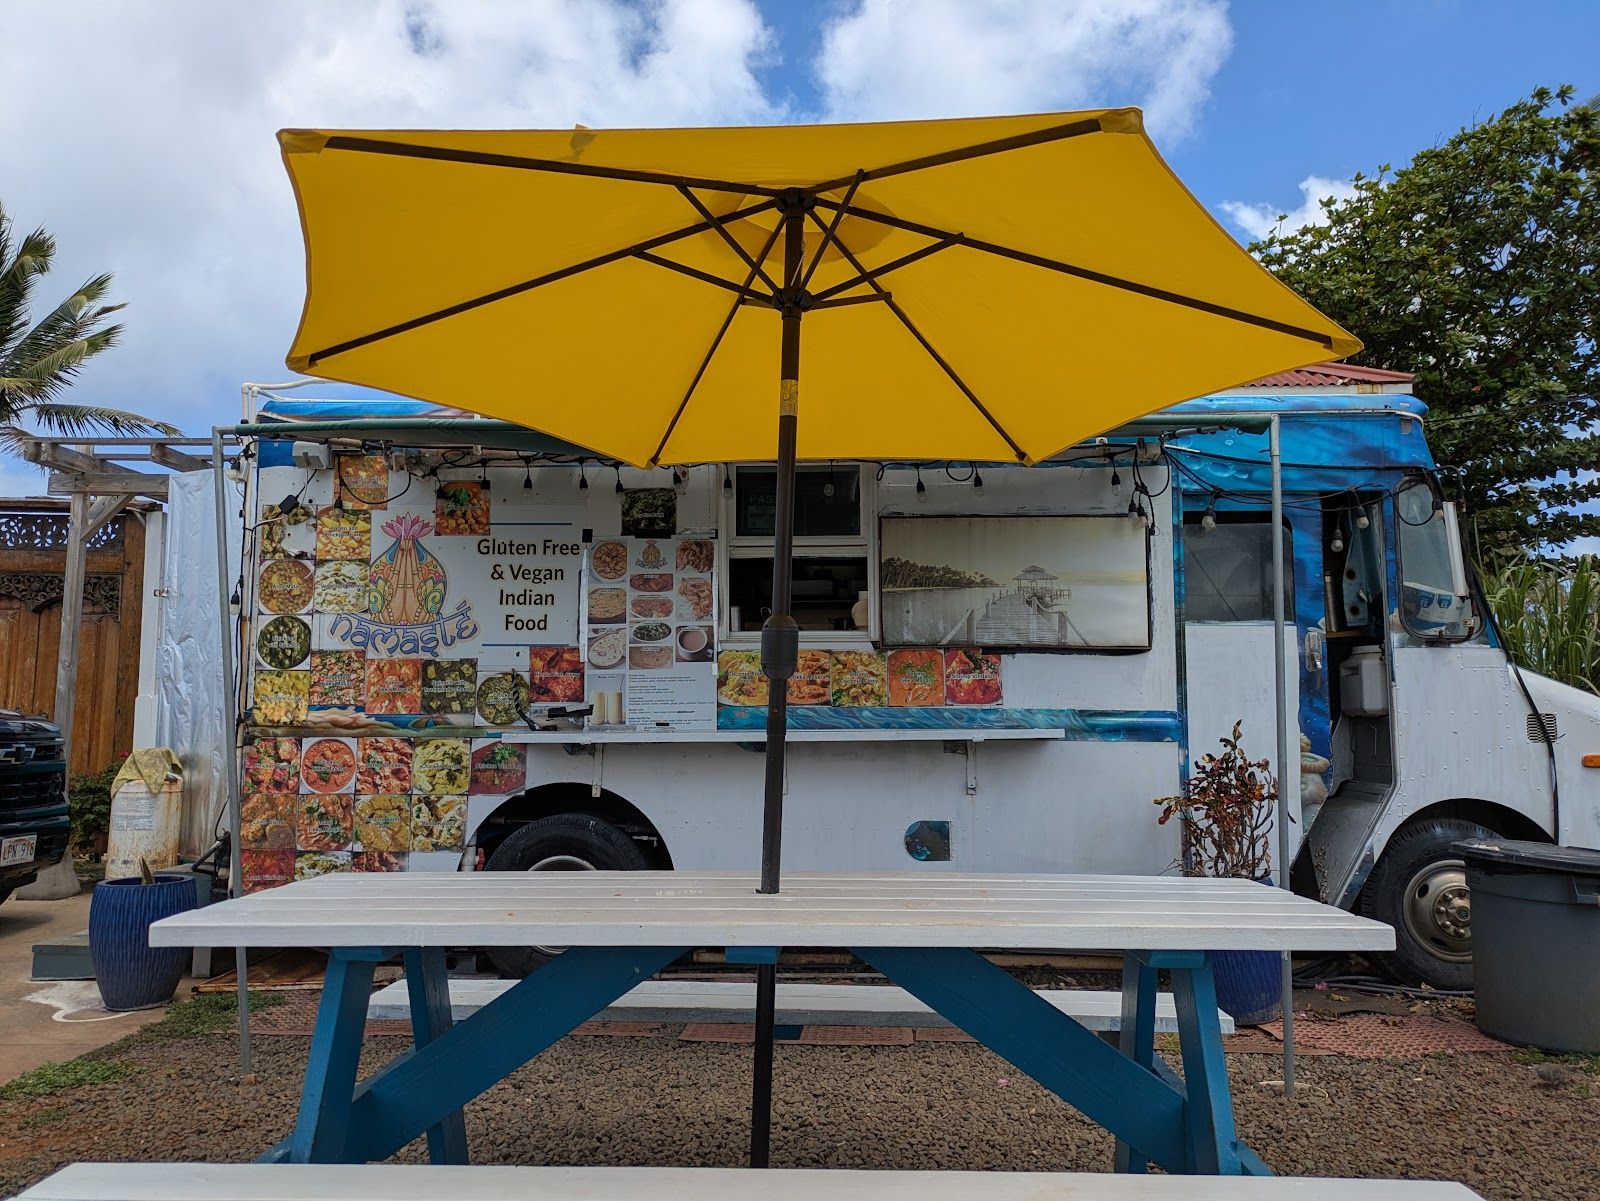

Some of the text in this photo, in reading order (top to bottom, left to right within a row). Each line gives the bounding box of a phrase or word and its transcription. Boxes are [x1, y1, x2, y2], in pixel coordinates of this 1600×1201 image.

[478, 539, 580, 555] Gluten Free
[491, 564, 564, 584] & Vegan
[499, 589, 555, 606] Indian
[505, 614, 548, 631] Food
